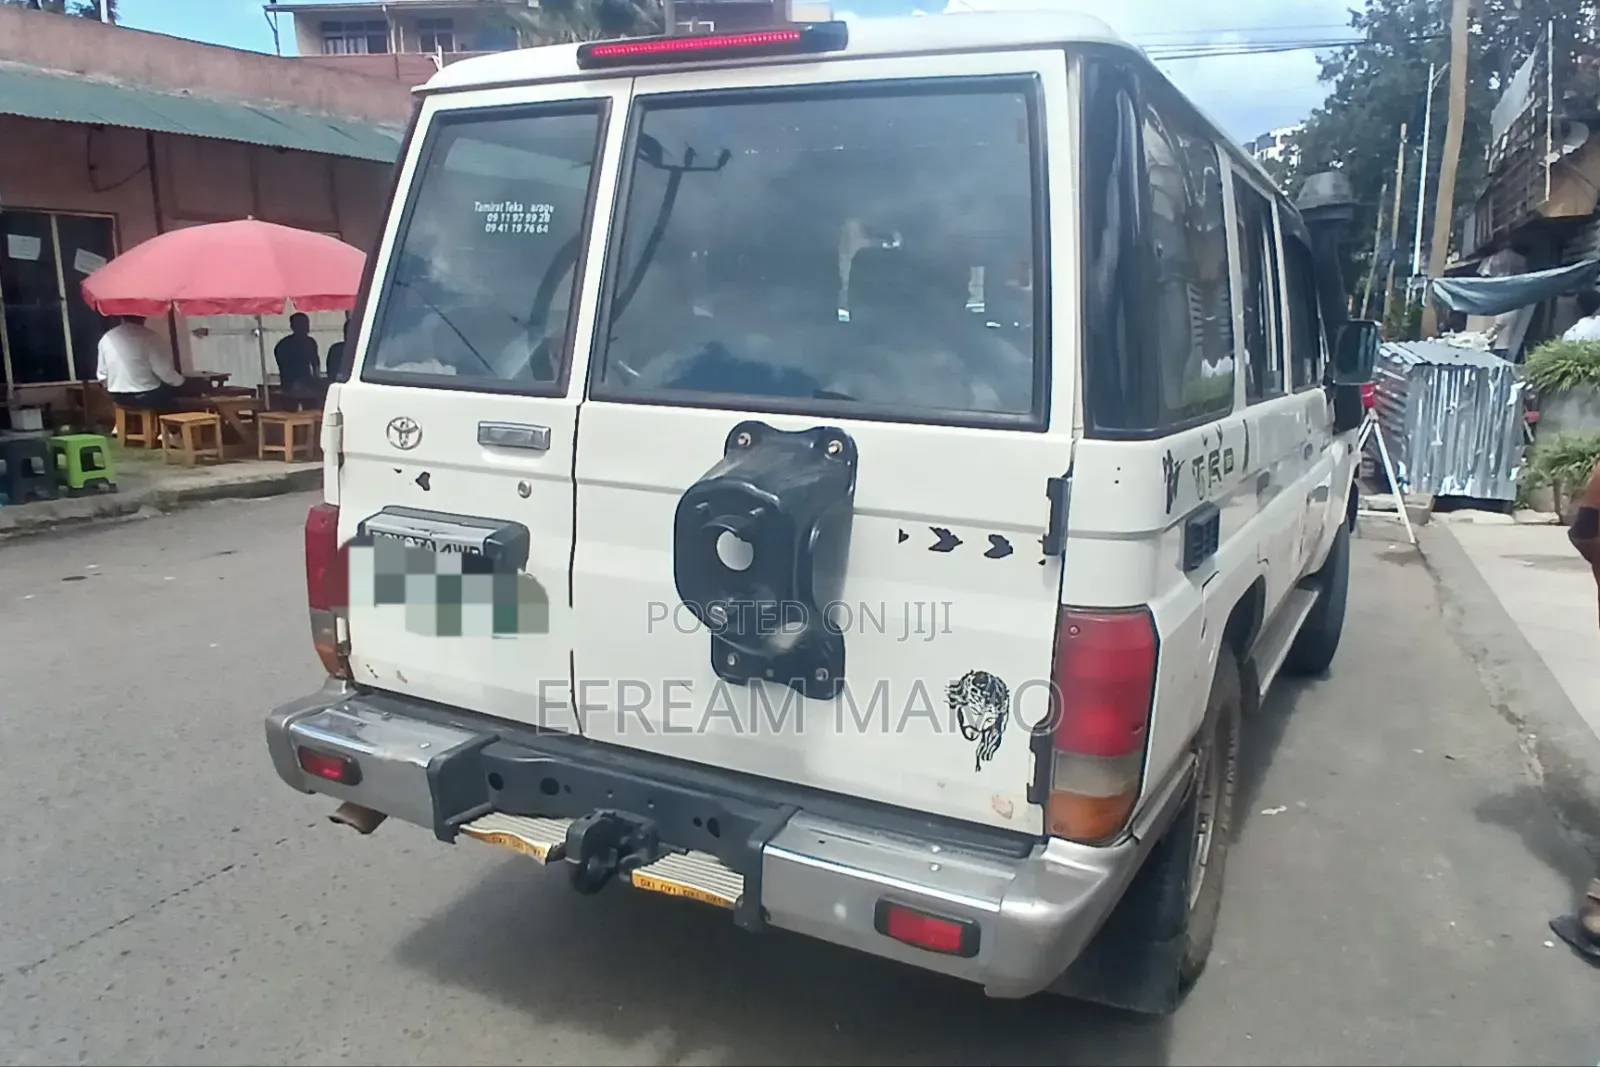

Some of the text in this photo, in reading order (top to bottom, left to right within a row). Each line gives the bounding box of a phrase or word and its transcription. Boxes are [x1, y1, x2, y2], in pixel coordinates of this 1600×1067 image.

[487, 212, 499, 222] 09
[485, 223, 497, 233] 09
[524, 224, 535, 233] 76
[536, 224, 549, 233] 64
